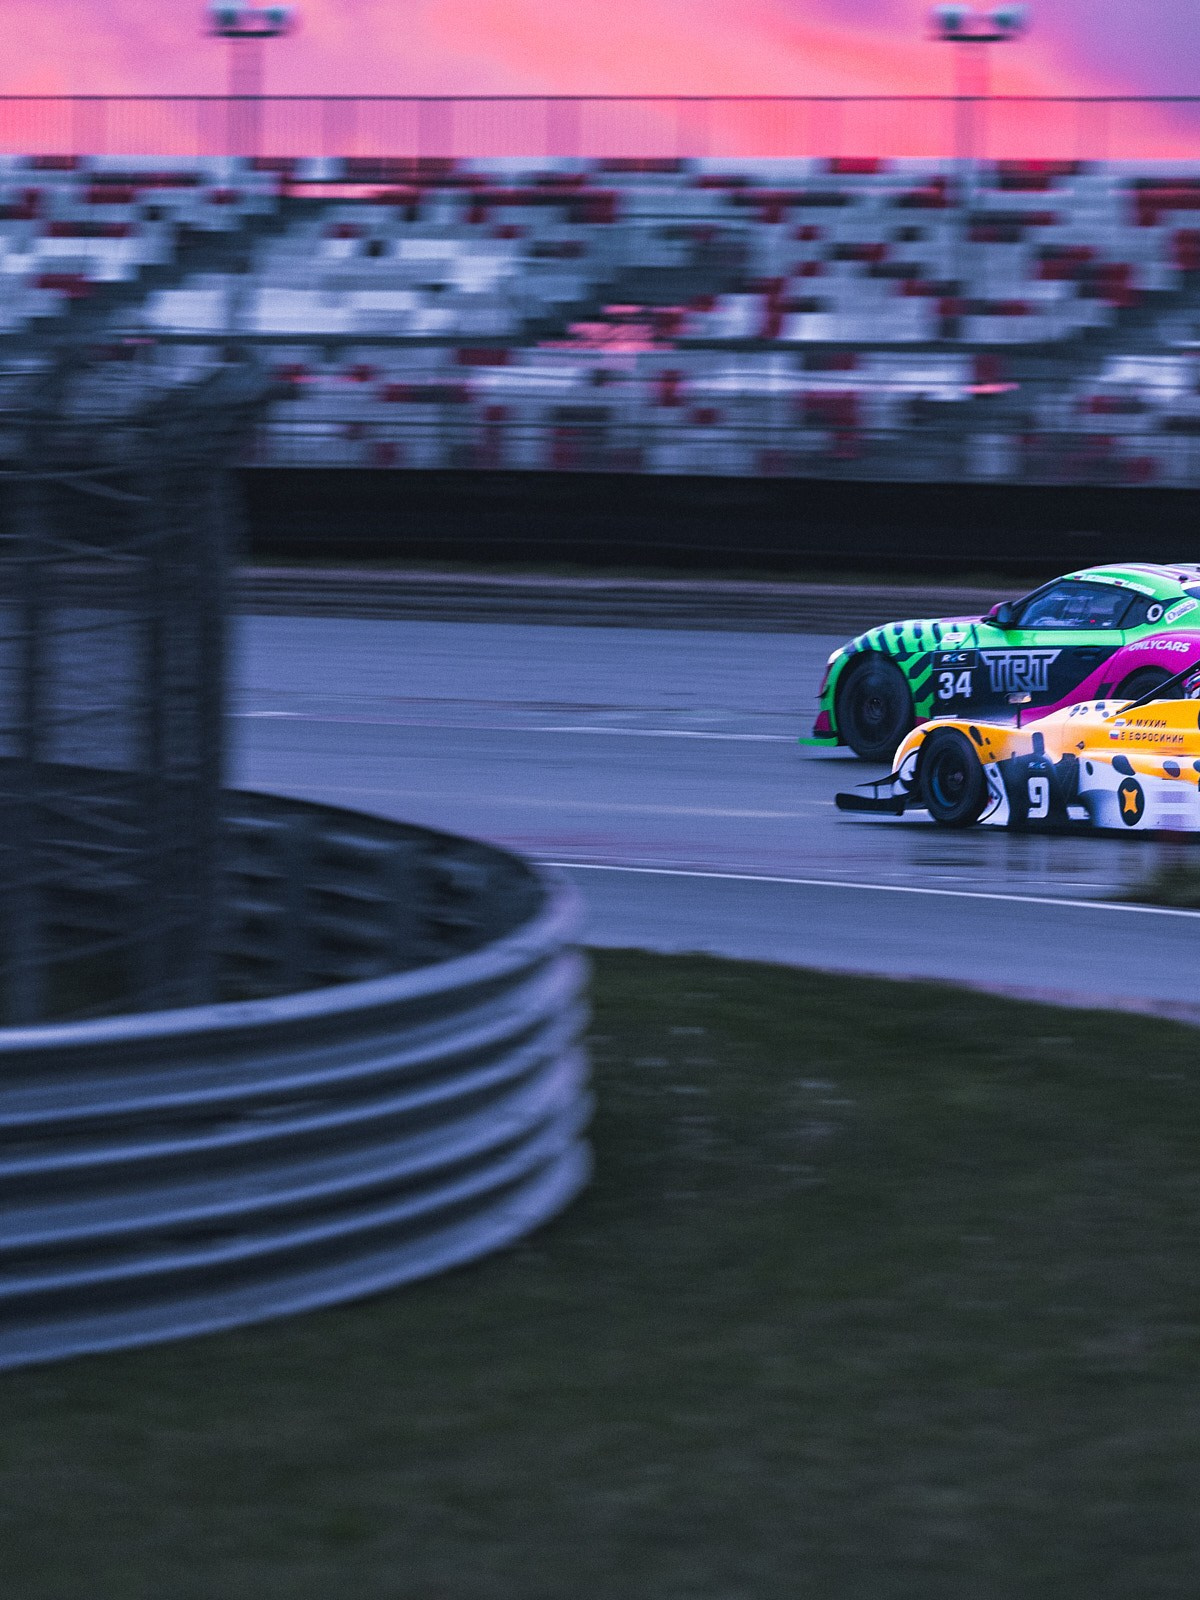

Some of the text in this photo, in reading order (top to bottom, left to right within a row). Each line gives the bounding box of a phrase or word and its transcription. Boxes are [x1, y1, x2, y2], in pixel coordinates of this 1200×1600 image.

[1128, 640, 1192, 653] ONLYCARS
[938, 671, 973, 700] 34
[1027, 776, 1049, 819] 9
